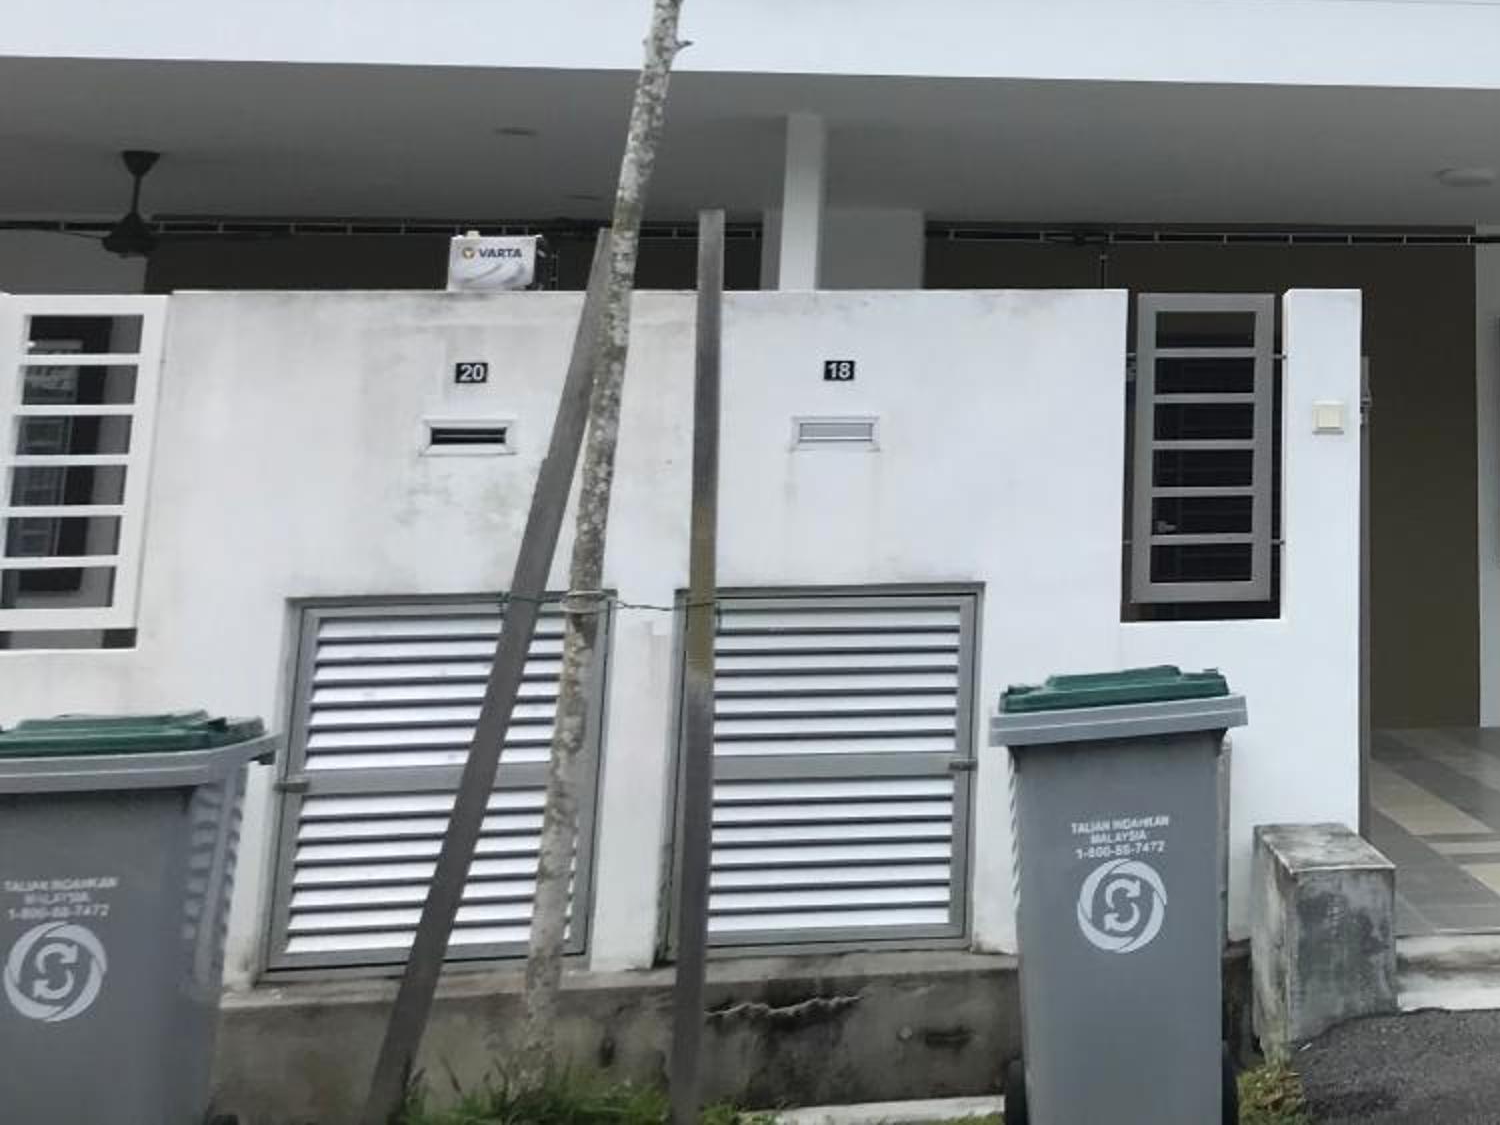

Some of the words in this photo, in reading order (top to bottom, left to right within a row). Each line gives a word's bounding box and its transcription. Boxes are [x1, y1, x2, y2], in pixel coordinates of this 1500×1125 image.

[479, 248, 522, 258] VARTA
[460, 365, 485, 380] 20
[828, 363, 851, 378] 18
[1091, 829, 1146, 844] MALAYSIA
